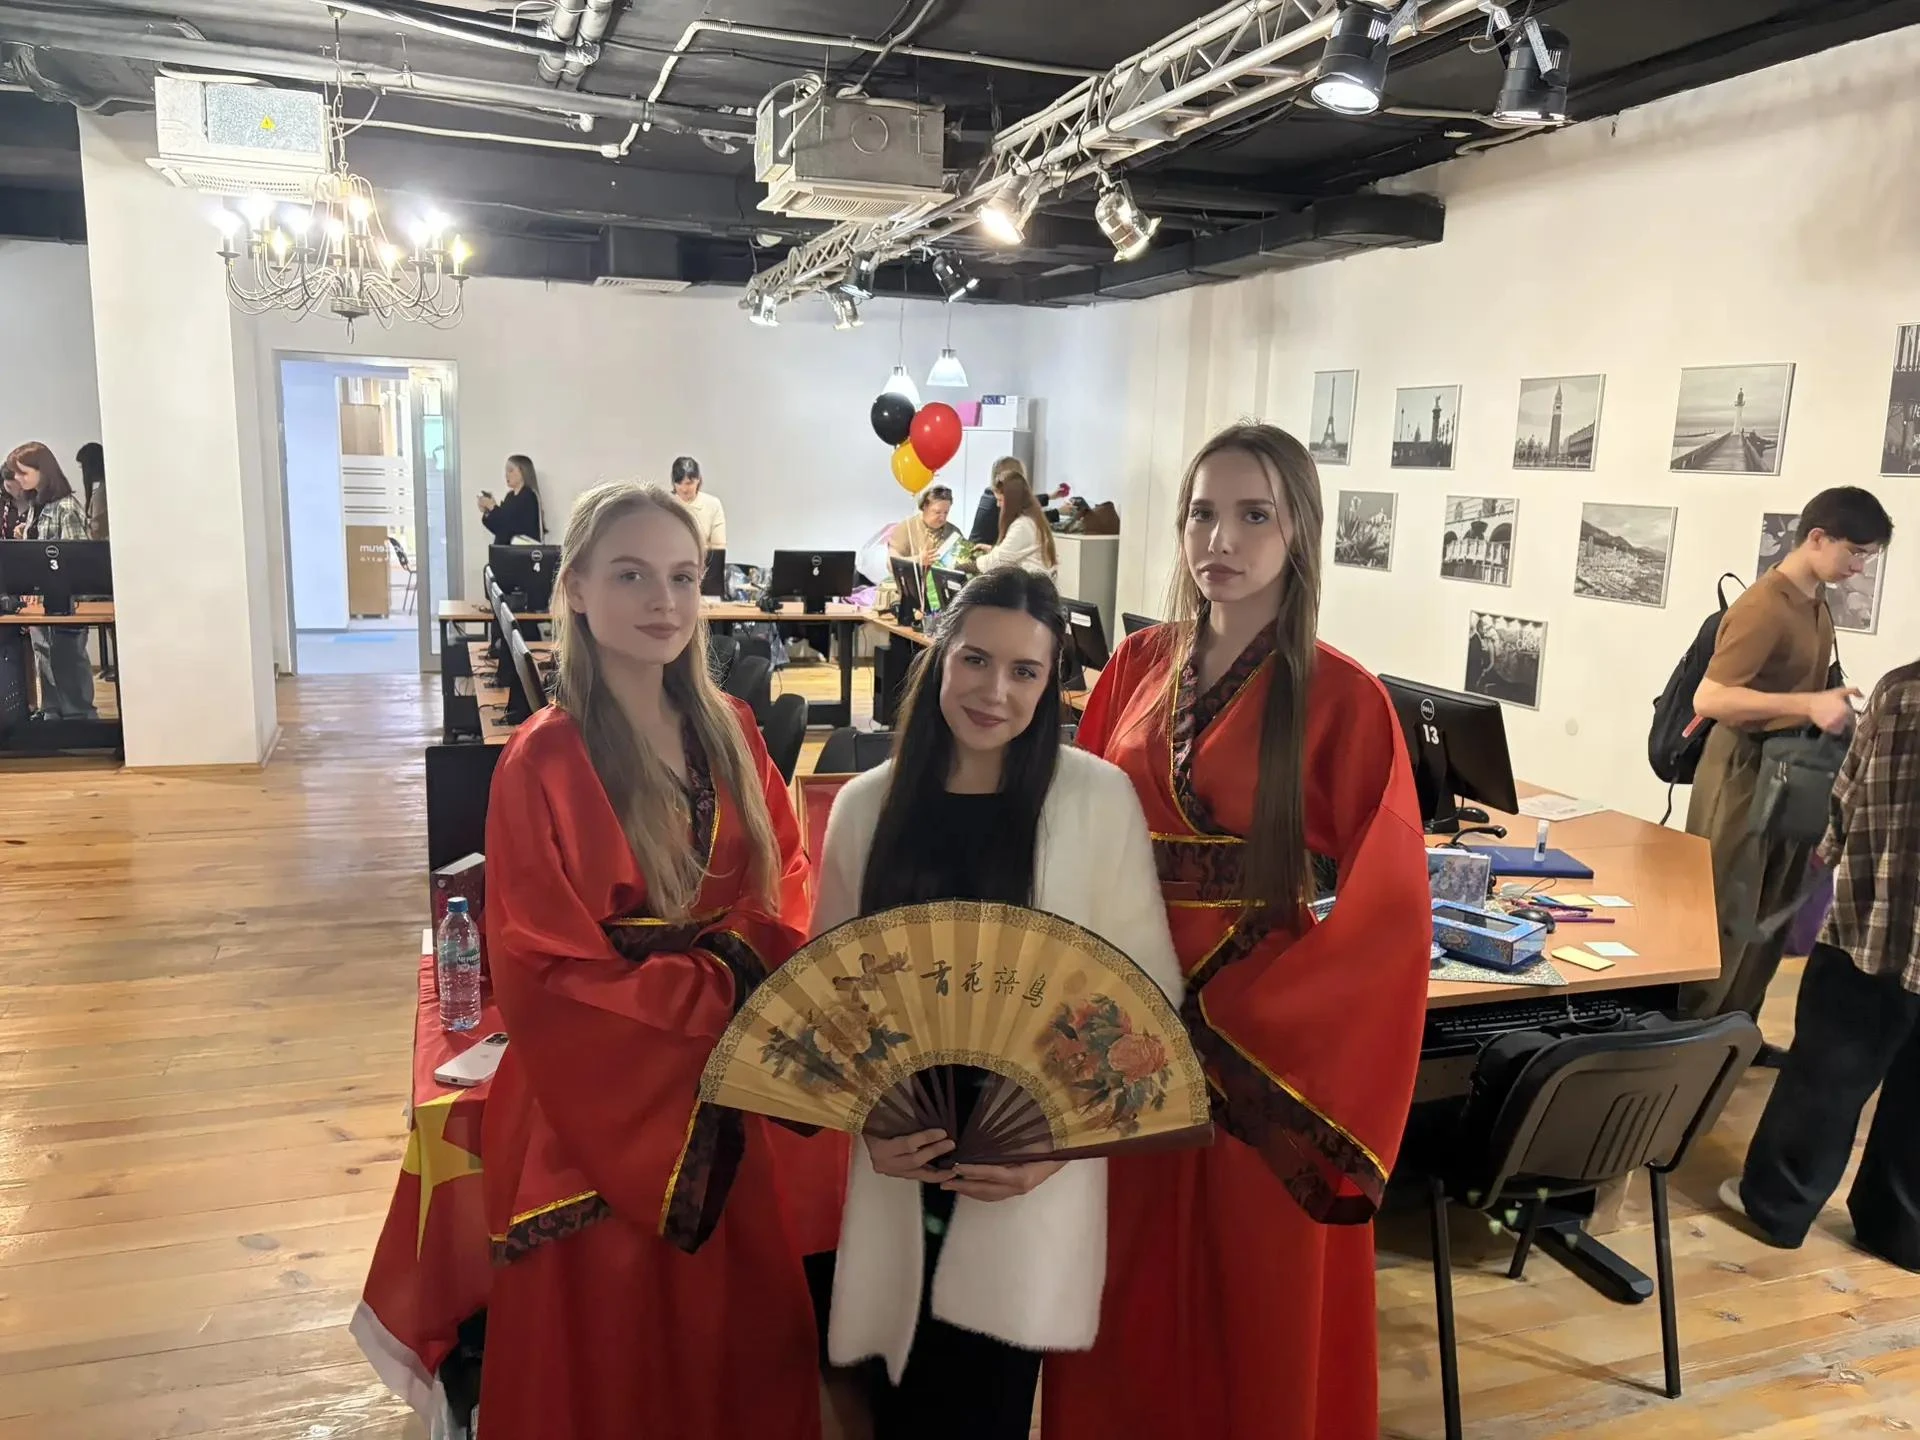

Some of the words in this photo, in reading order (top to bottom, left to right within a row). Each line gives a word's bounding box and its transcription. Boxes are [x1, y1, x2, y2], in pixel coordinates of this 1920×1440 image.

[50, 559, 59, 570] 3
[533, 562, 541, 573] 4
[812, 566, 820, 576] 6
[1422, 723, 1440, 745] 13
